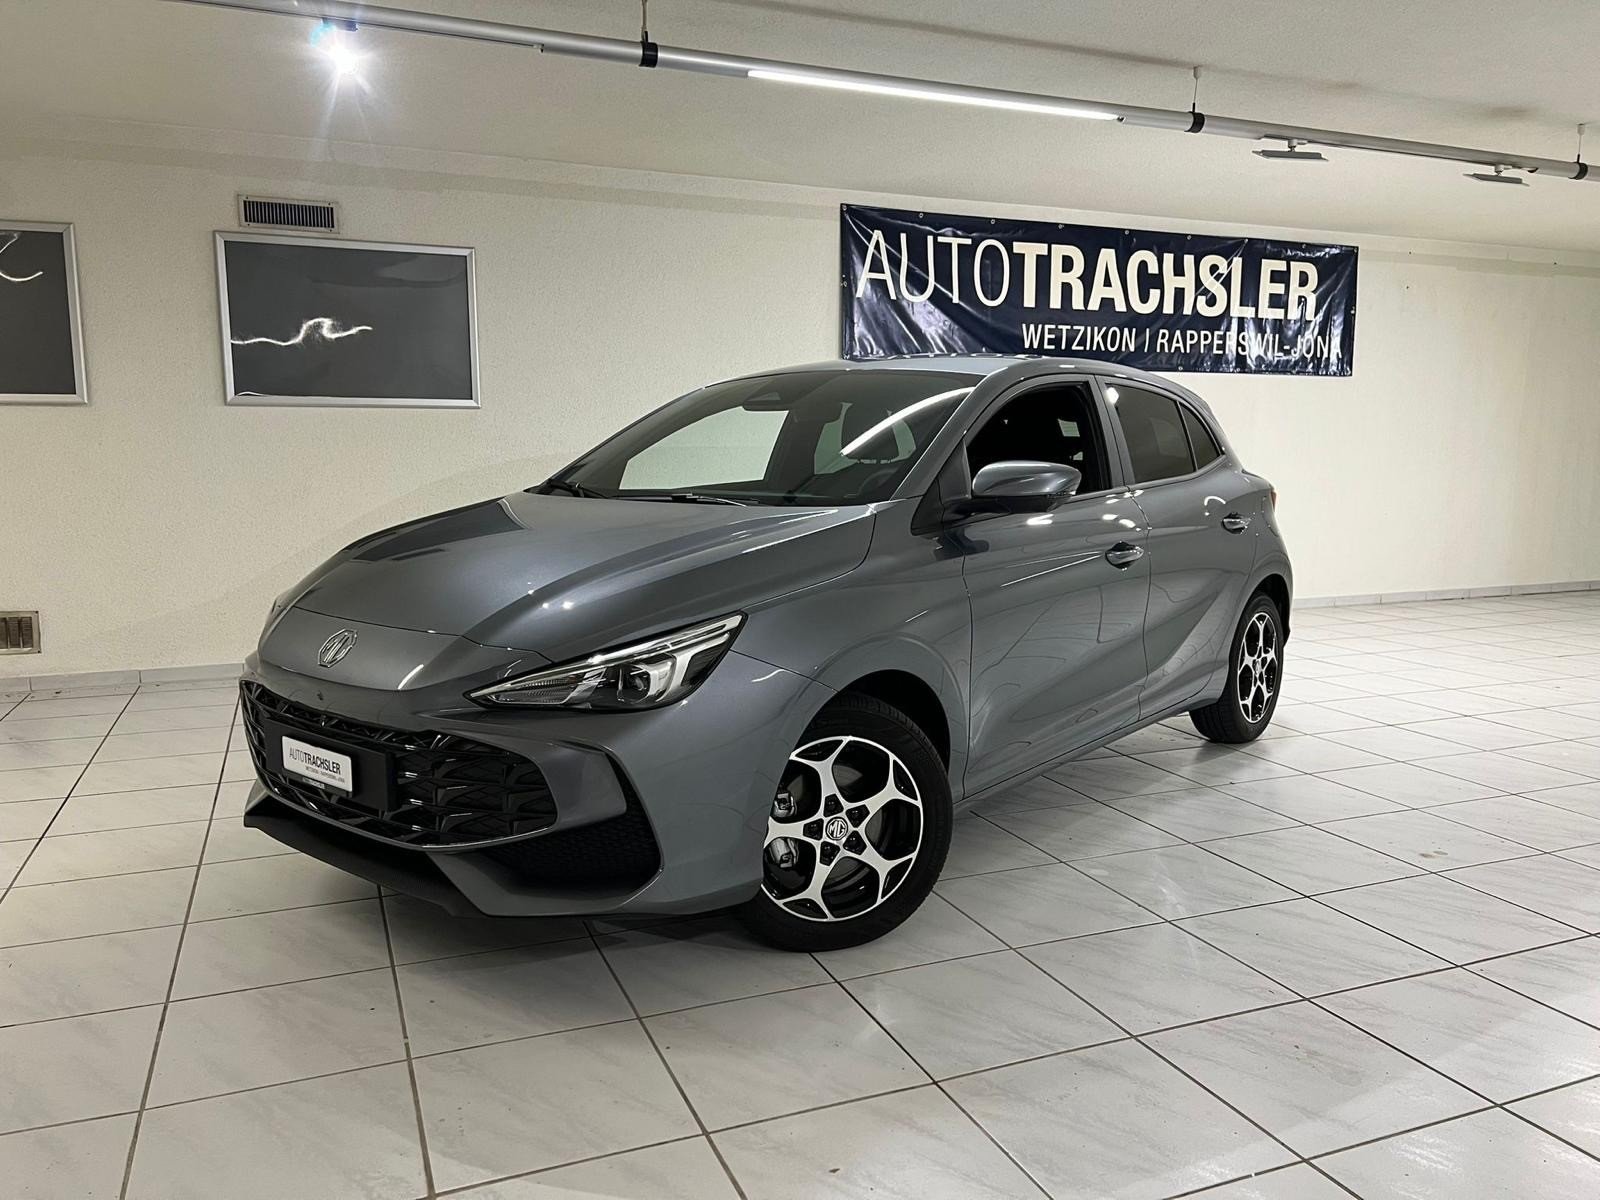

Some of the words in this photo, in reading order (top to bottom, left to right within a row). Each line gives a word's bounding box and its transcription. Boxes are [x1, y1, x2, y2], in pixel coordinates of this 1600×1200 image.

[856, 229, 1318, 321] AUTOTRACHSLER
[1022, 323, 1136, 352] WETZIKON
[289, 746, 341, 775] AUTOTRACHSLER
[829, 819, 847, 838] MG
